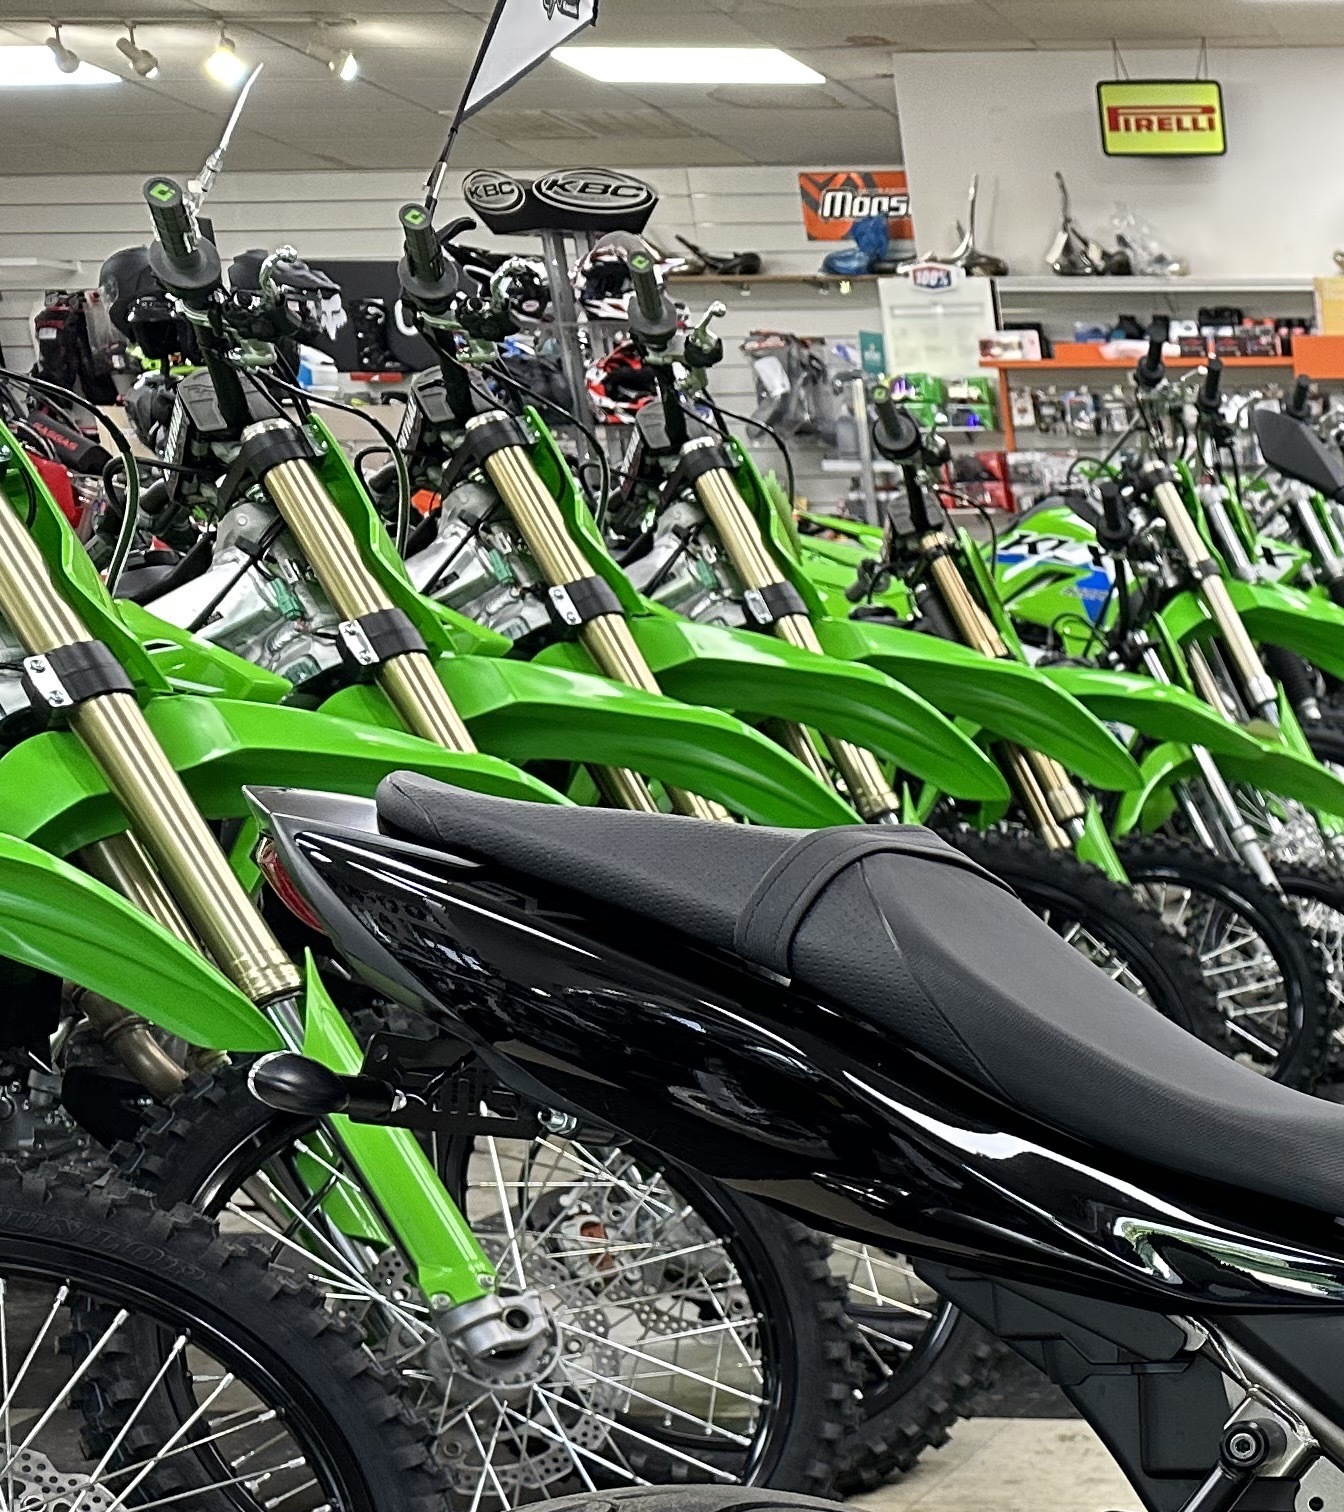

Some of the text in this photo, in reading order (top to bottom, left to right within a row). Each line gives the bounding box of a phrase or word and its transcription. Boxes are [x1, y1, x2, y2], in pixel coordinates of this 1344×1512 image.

[1107, 105, 1215, 132] PIRELLI
[467, 180, 516, 200] KBC
[545, 178, 644, 198] KBC
[822, 190, 912, 218] Moos
